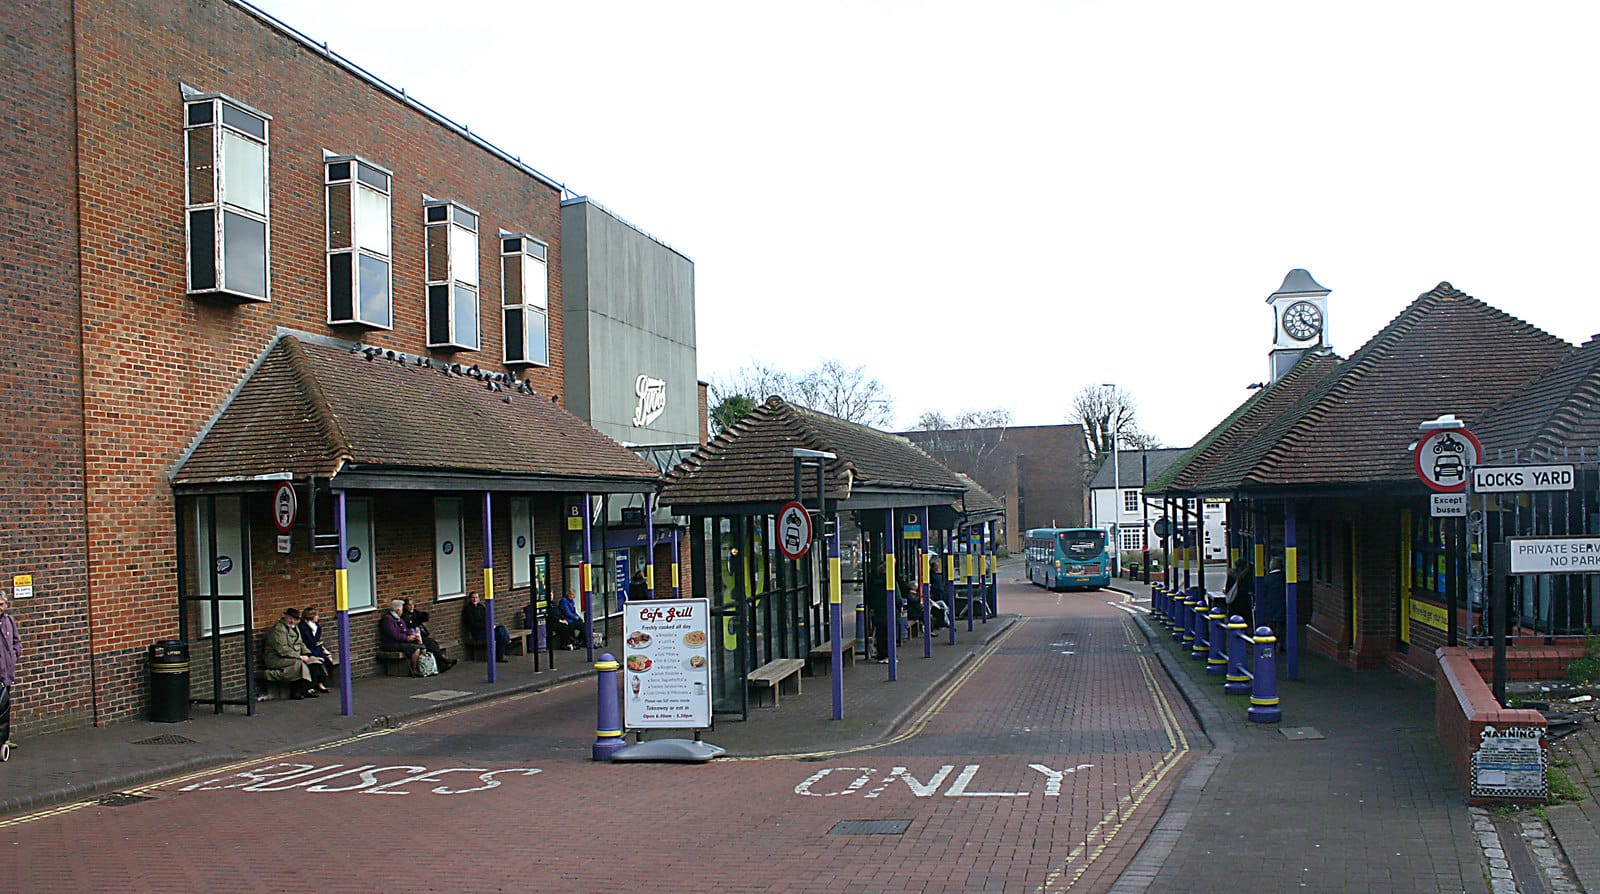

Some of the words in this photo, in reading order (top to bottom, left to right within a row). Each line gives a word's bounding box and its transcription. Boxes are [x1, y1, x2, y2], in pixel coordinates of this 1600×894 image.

[1477, 473, 1524, 487] LOCKS
[1532, 470, 1571, 485] YARD
[1434, 496, 1463, 505] Except
[571, 505, 579, 516] B
[907, 513, 918, 524] D
[1519, 544, 1567, 554] PRIVATE
[1550, 557, 1568, 566] NO
[640, 607, 664, 623] Cafe
[666, 606, 693, 622] Grill
[1483, 730, 1536, 738] WARNING
[179, 763, 542, 795] BUSES
[794, 764, 1095, 798] ONLY
